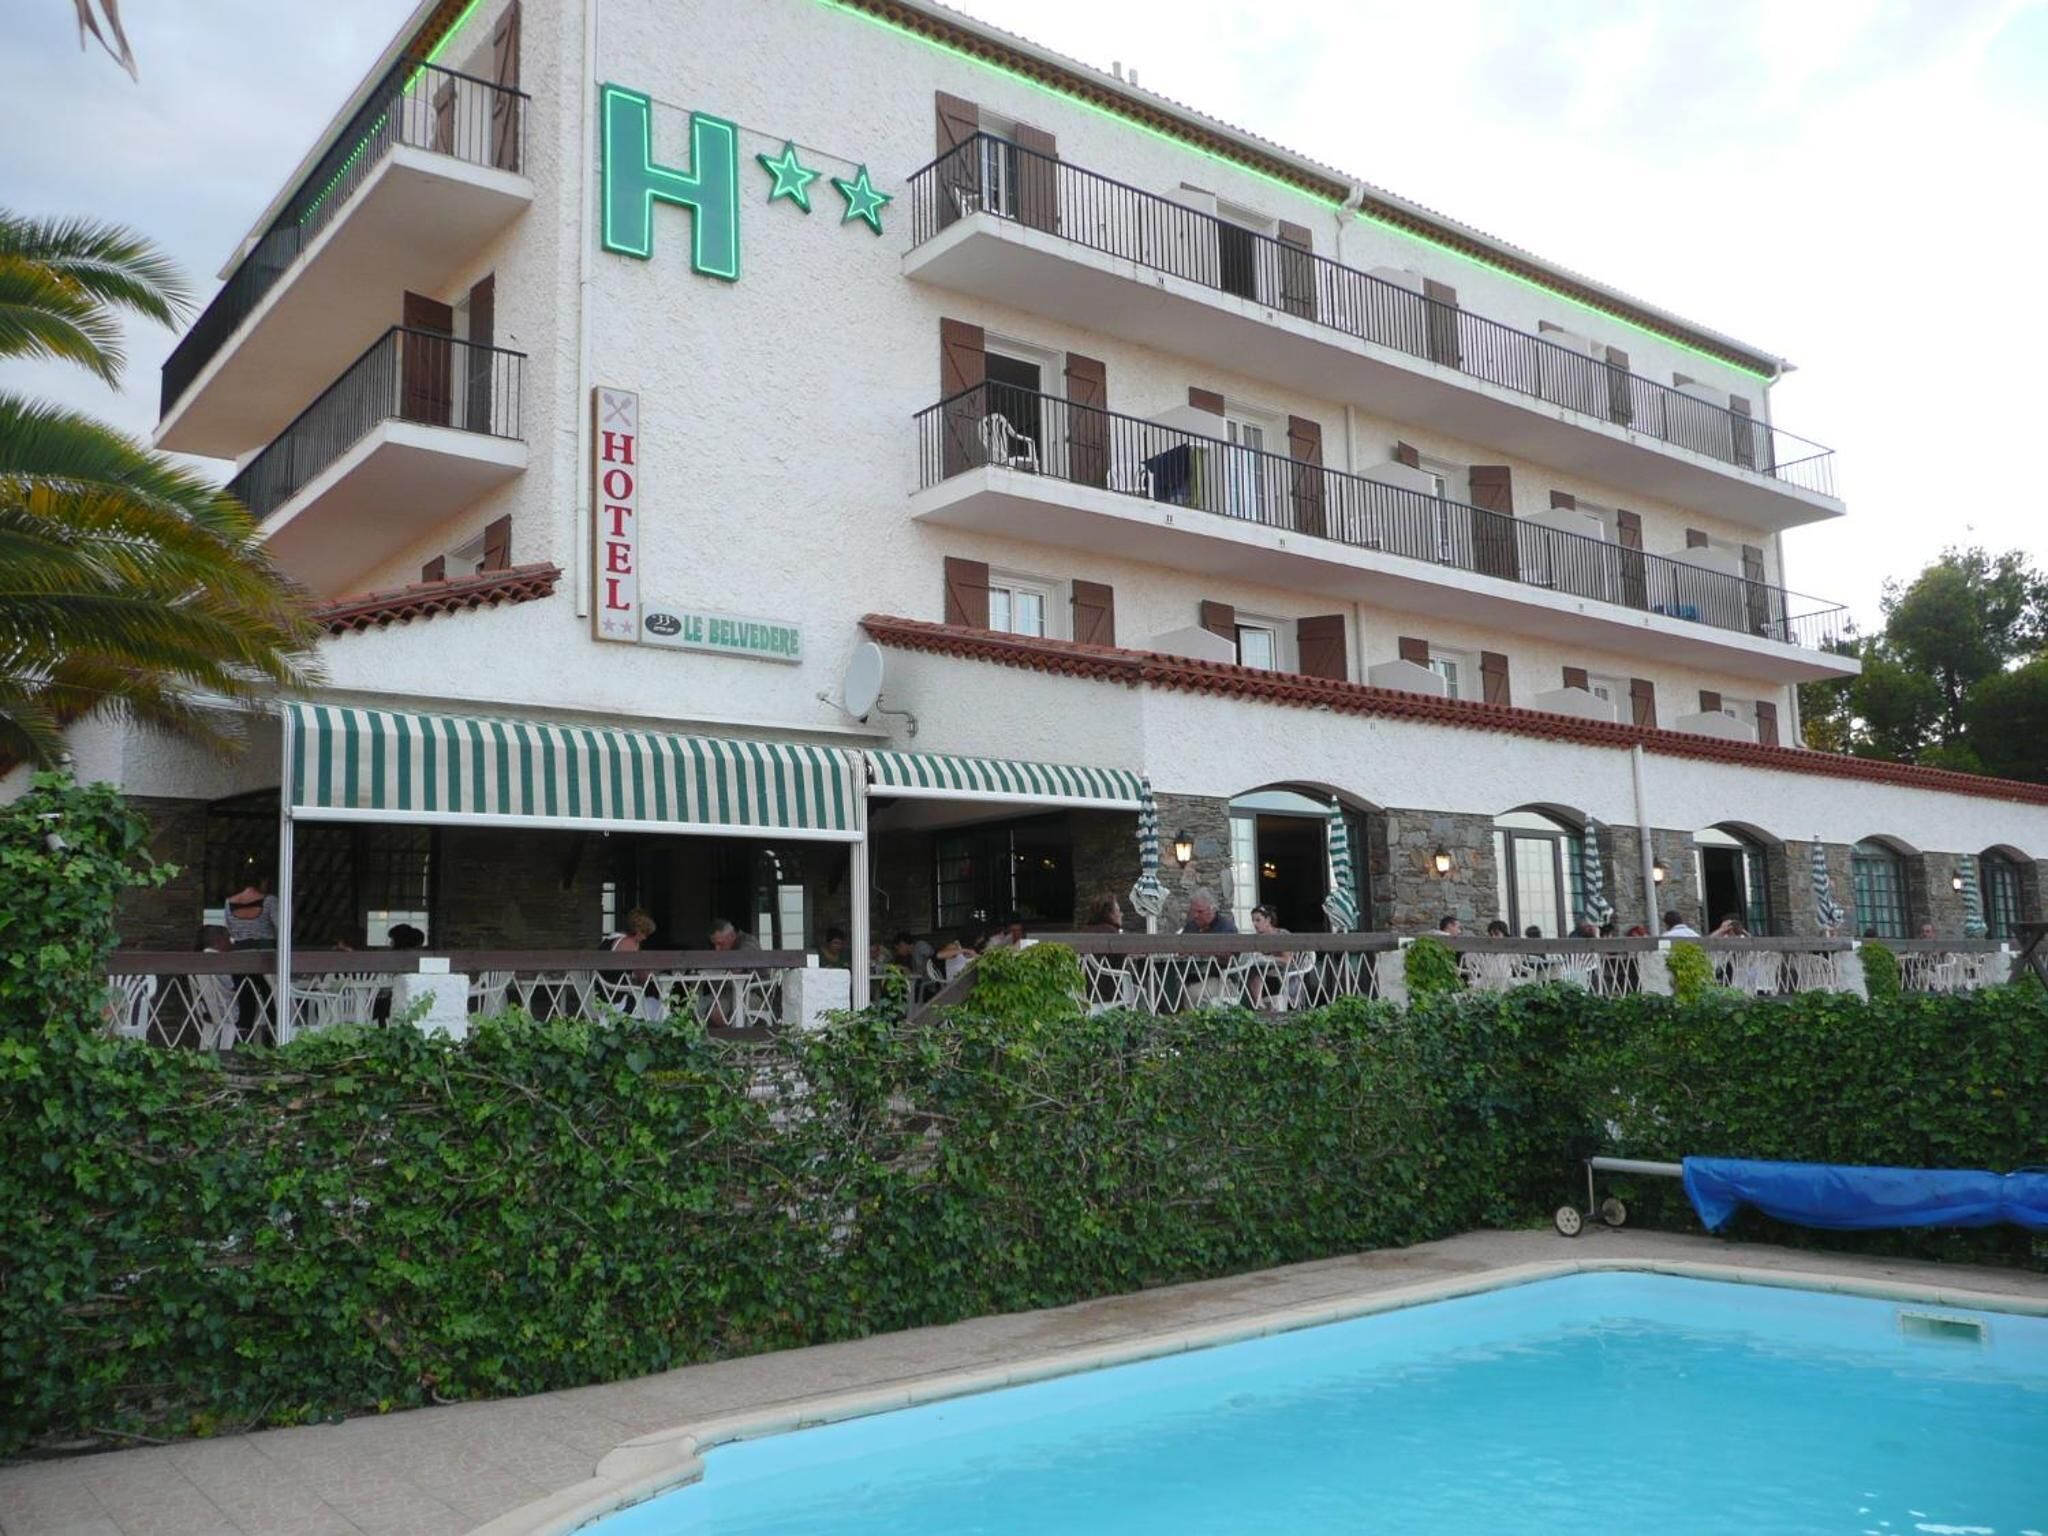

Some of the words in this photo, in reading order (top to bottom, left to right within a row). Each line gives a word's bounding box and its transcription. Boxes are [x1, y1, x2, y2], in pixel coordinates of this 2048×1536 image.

[601, 82, 738, 281] H
[602, 431, 634, 610] HOTEL
[684, 614, 703, 642] LE
[708, 618, 798, 656] BELVEDERE
